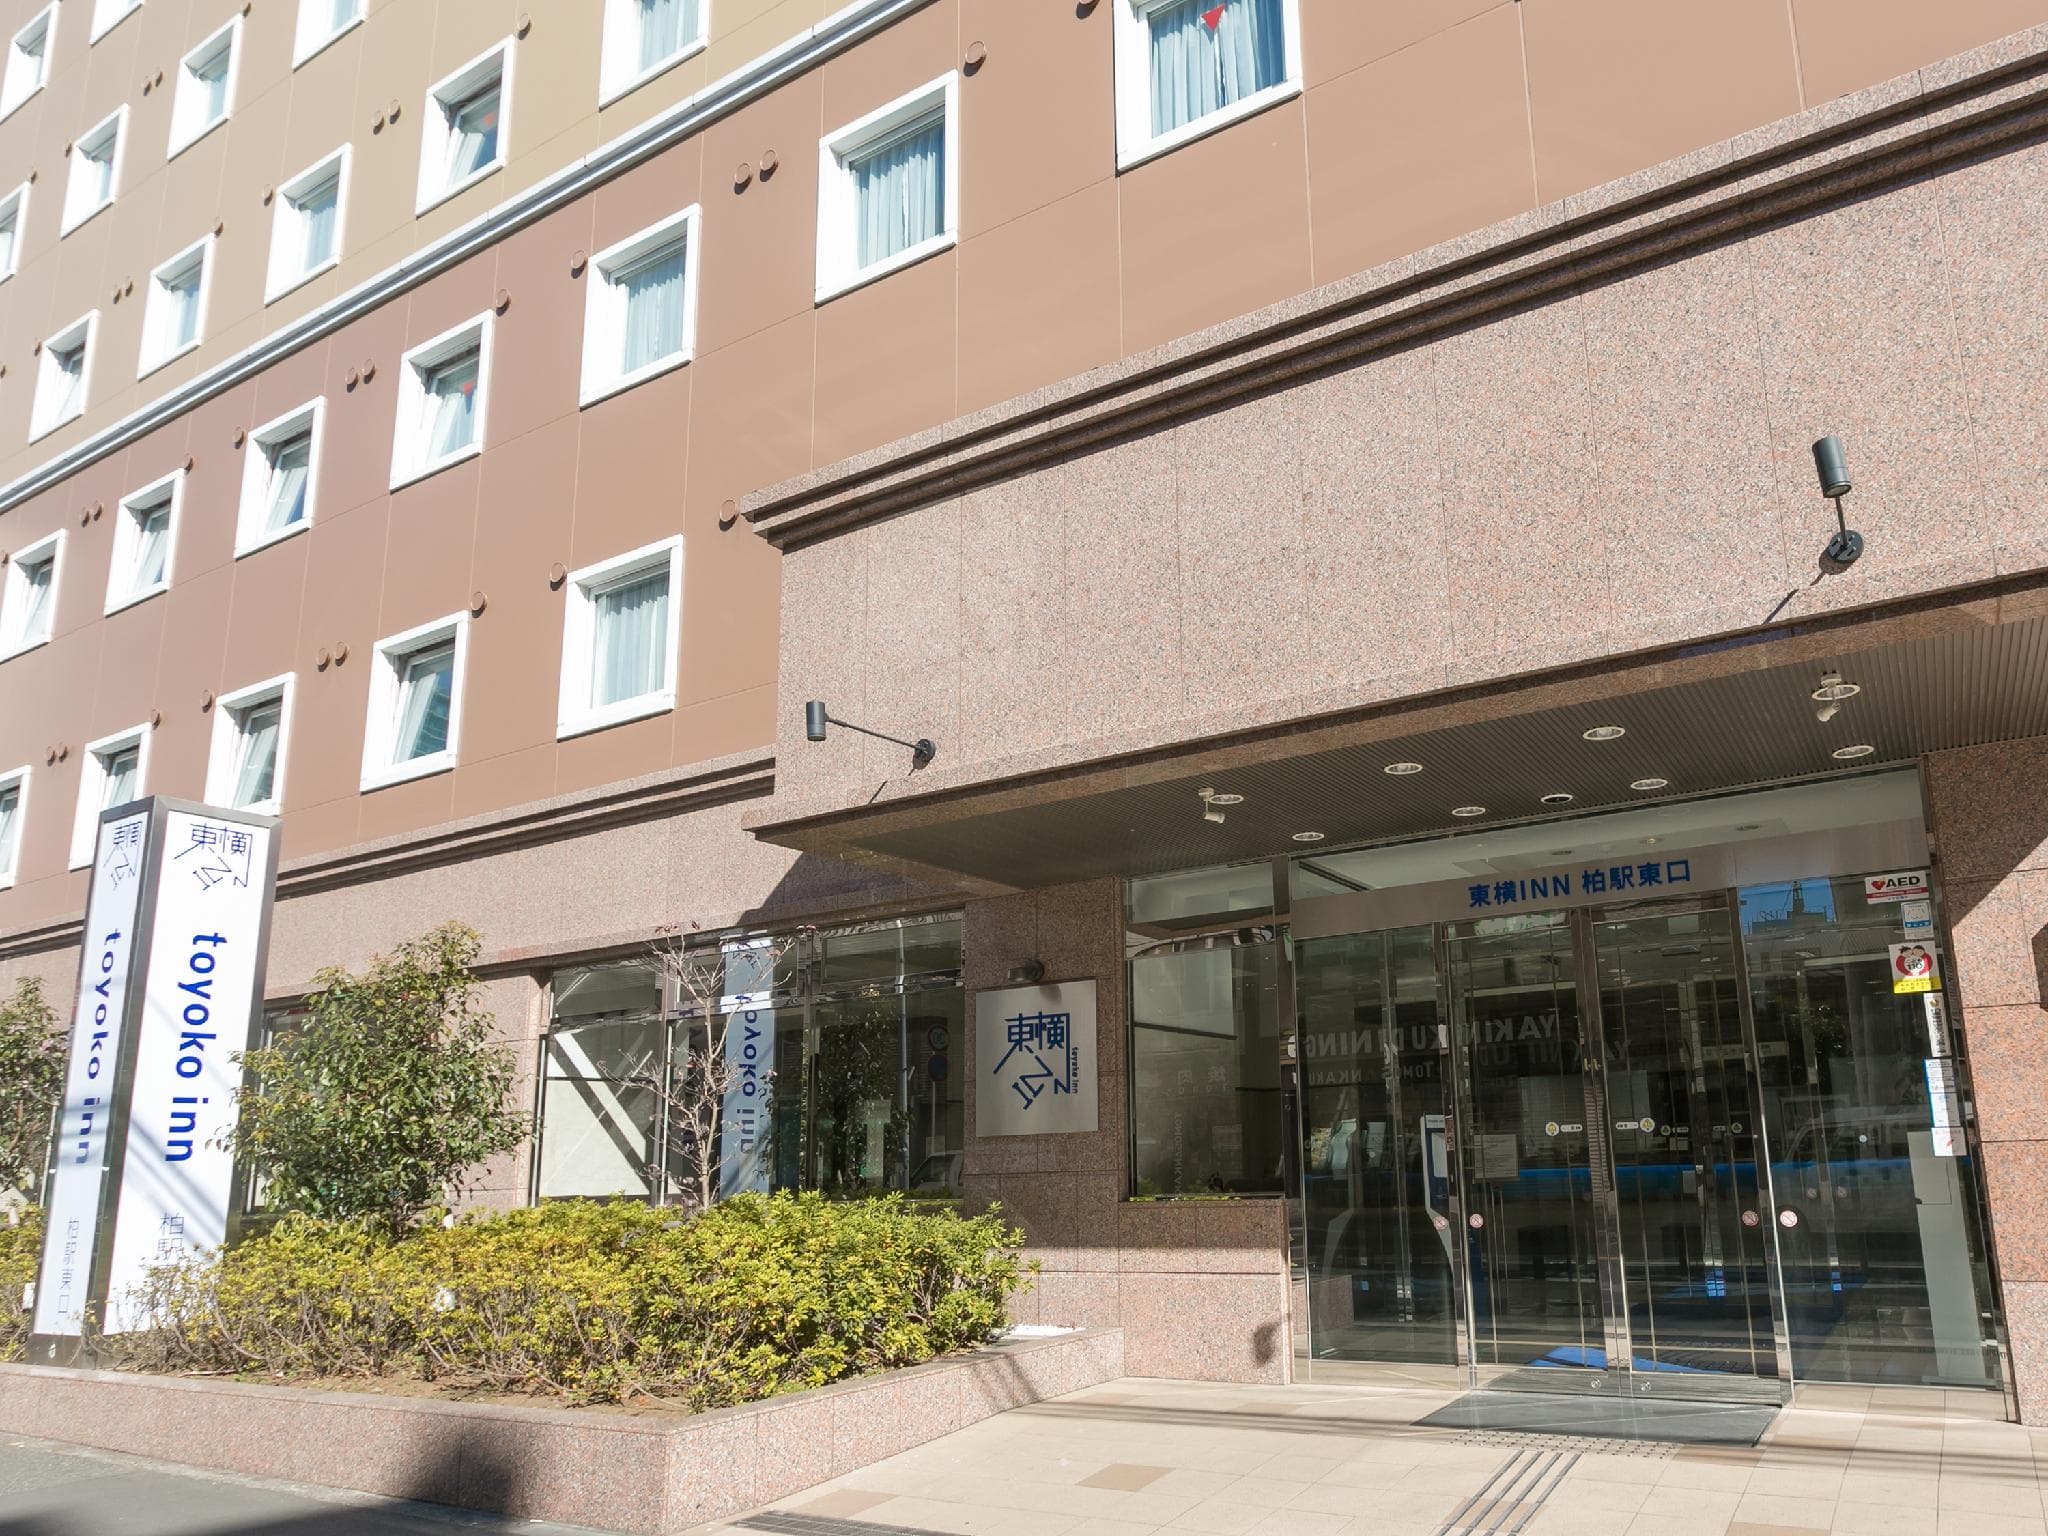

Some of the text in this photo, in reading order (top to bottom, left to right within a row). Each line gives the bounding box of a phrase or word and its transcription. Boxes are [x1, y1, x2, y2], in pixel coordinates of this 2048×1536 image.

[1468, 858, 1691, 908] 東横INN 柏駅東口
[1885, 876, 1921, 888] AED
[76, 930, 121, 1164] toyoko inn
[164, 932, 227, 1163] toyoko inn
[1071, 1080, 1080, 1094] inn
[157, 1212, 185, 1266] 柏駅
